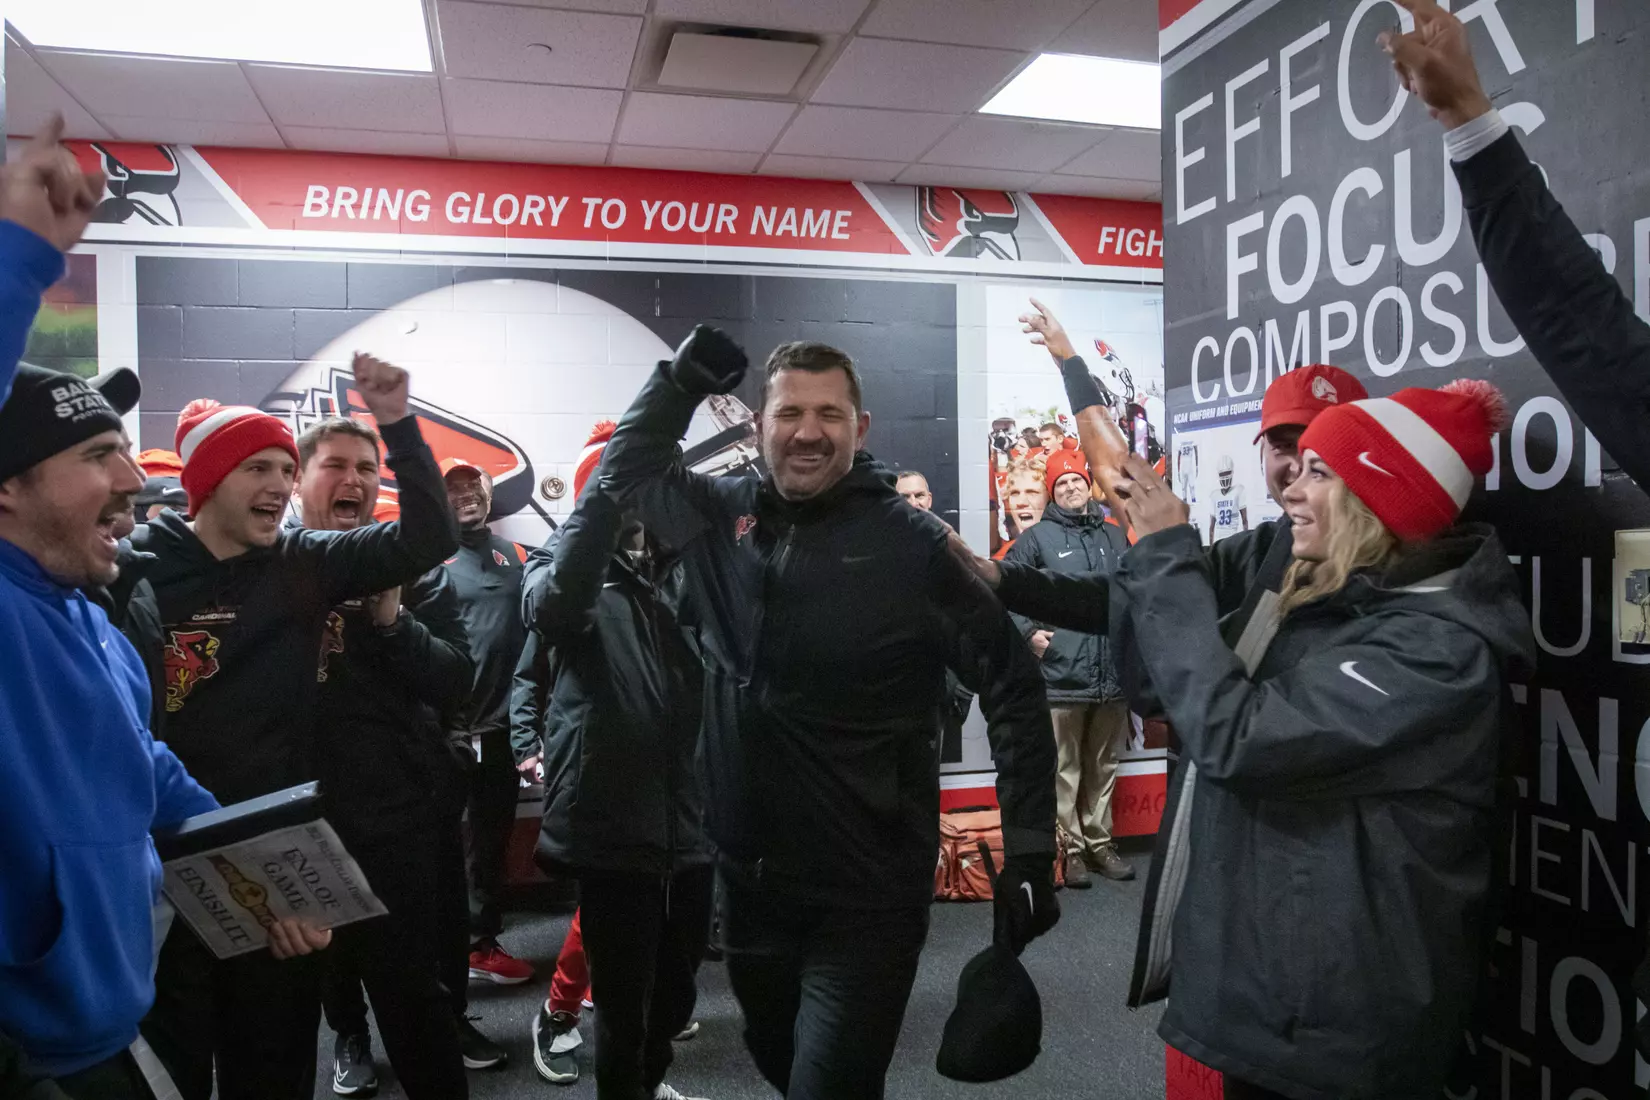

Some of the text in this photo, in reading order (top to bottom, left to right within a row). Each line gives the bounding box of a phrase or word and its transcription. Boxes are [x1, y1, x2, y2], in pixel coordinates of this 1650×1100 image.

[1175, 0, 1594, 225] EFFO
[302, 185, 852, 239] BRING GLORY TO YOUR NAME
[1226, 101, 1549, 320] FOCU
[1098, 226, 1163, 257] FIGH
[51, 381, 100, 402] BAL
[55, 395, 108, 418] STAT
[1173, 399, 1263, 424] NCAA UNIFORM AND EQUIPMEN
[1219, 509, 1232, 525] 33
[192, 612, 236, 620] CARDINAL
[264, 861, 309, 911] GAME
[284, 847, 320, 886] END
[314, 884, 340, 909] OF
[178, 867, 251, 942] FINISH IT
